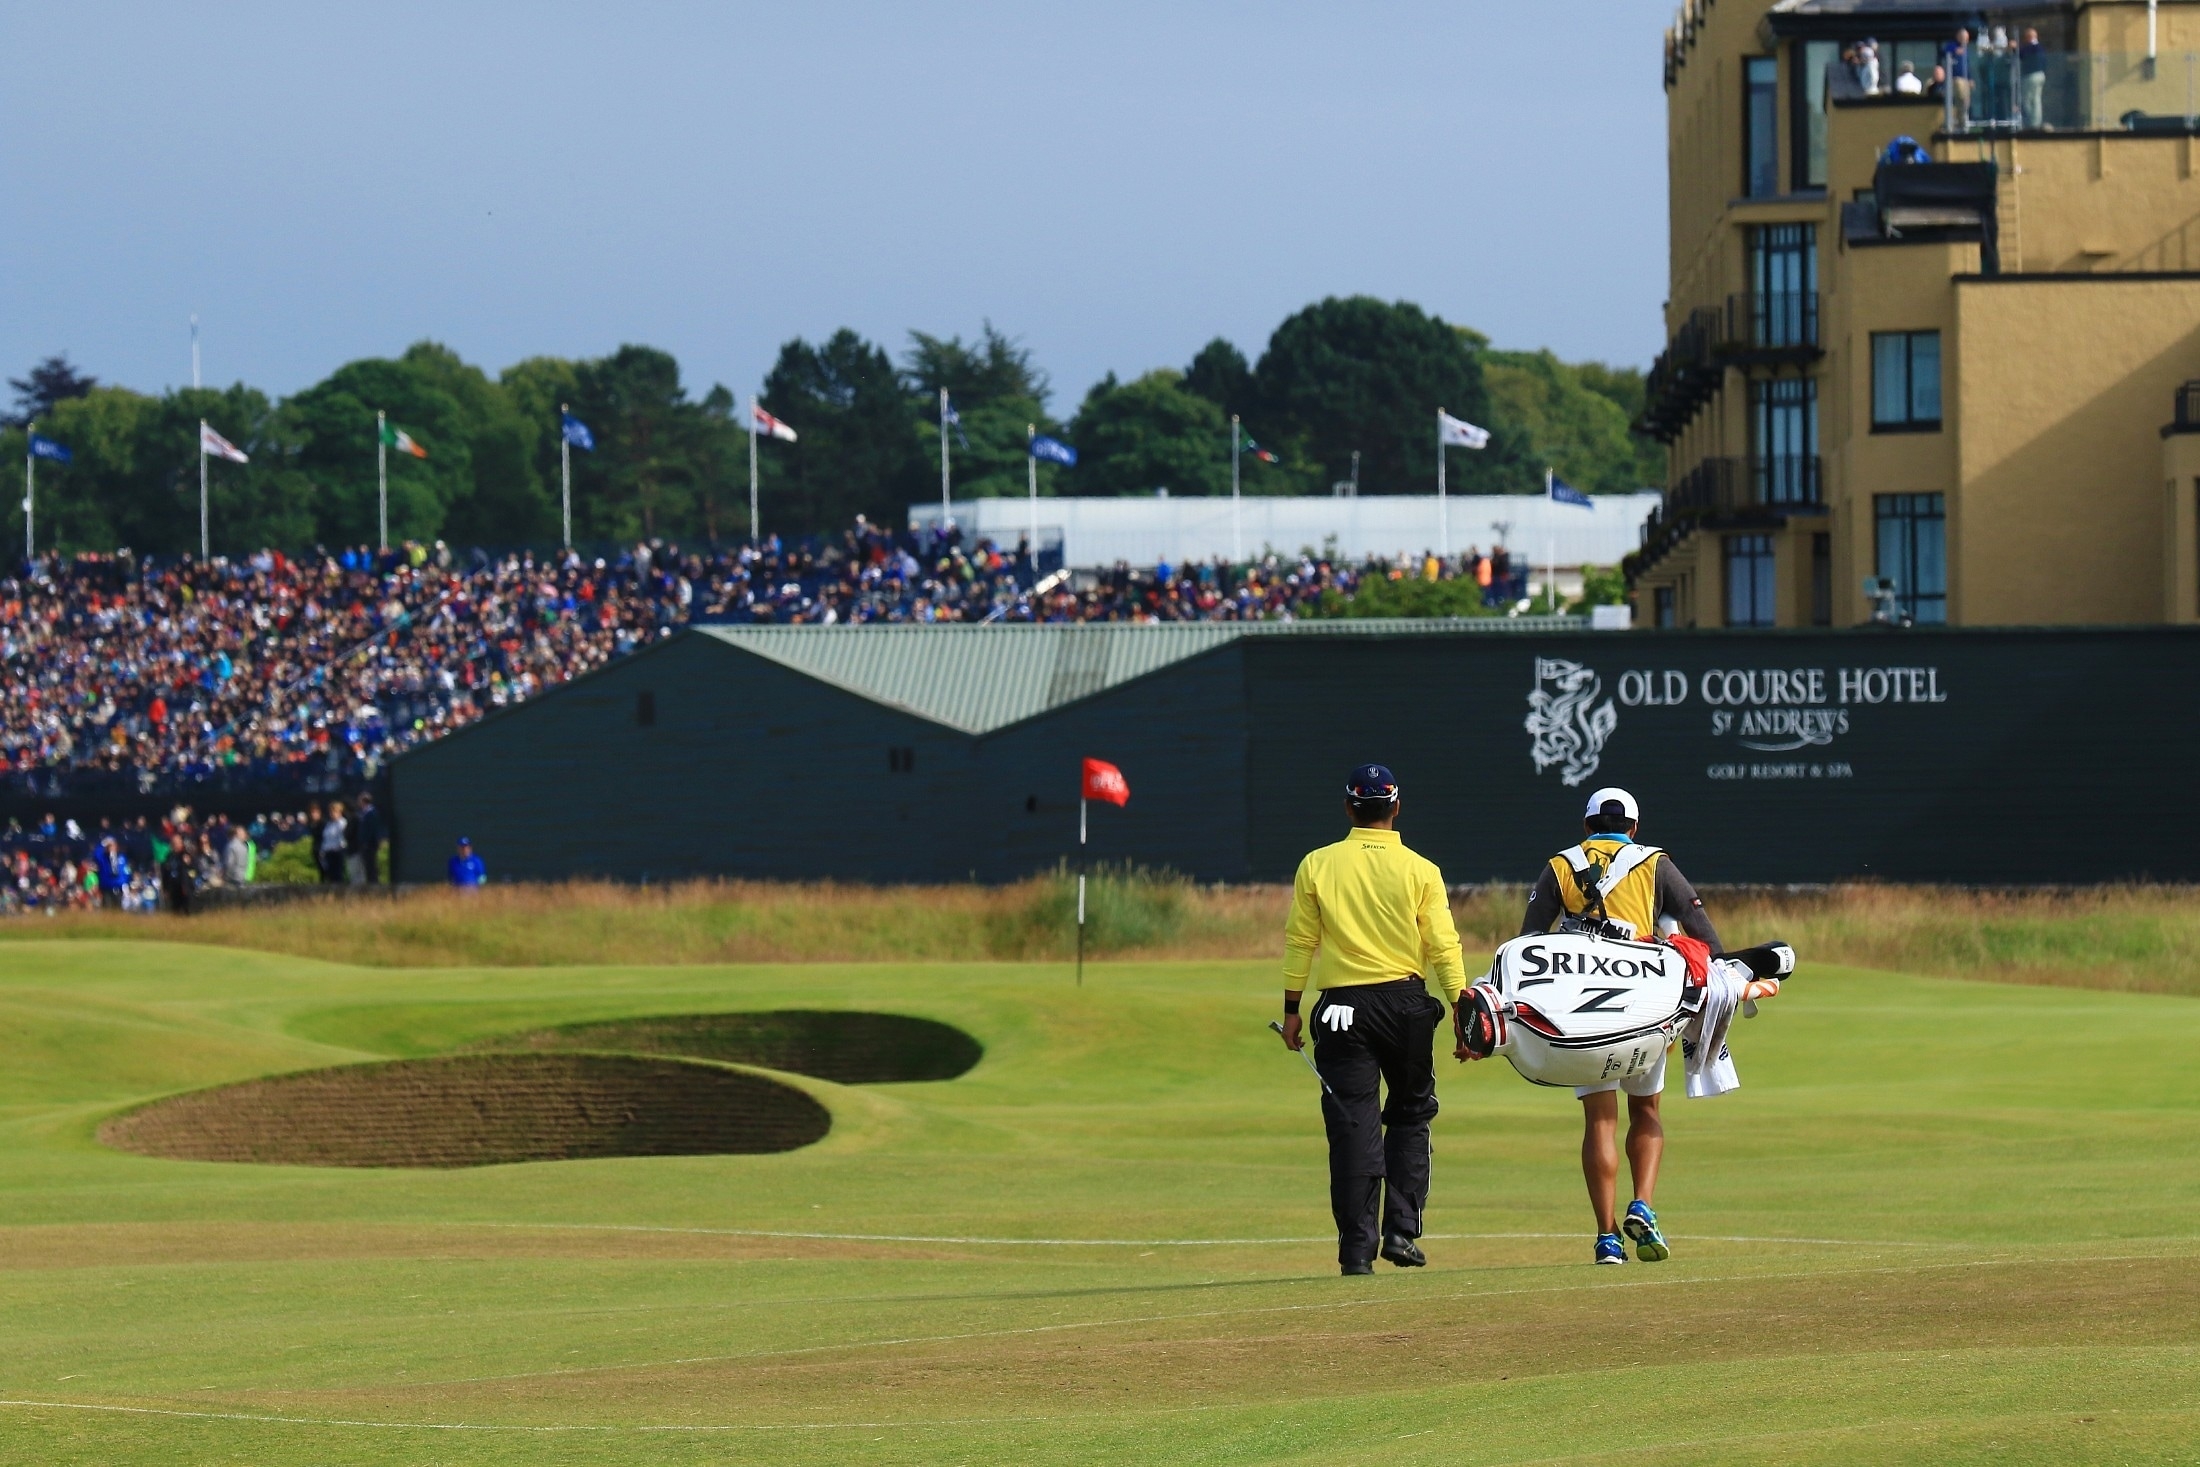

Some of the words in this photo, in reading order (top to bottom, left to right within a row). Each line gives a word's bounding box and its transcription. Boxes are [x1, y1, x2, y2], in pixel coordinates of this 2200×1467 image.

[1617, 670, 1689, 706] OLD
[1701, 668, 1827, 706] COURSE
[1838, 666, 1947, 704] HOTEL
[1740, 708, 1850, 742] ANDREWS
[1706, 763, 1746, 780] GOLF
[1750, 762, 1805, 779] RESORT
[1809, 763, 1823, 778] &
[1827, 761, 1853, 778] SPA
[1520, 944, 1666, 979] SRIXON
[1570, 987, 1634, 1014] Z
